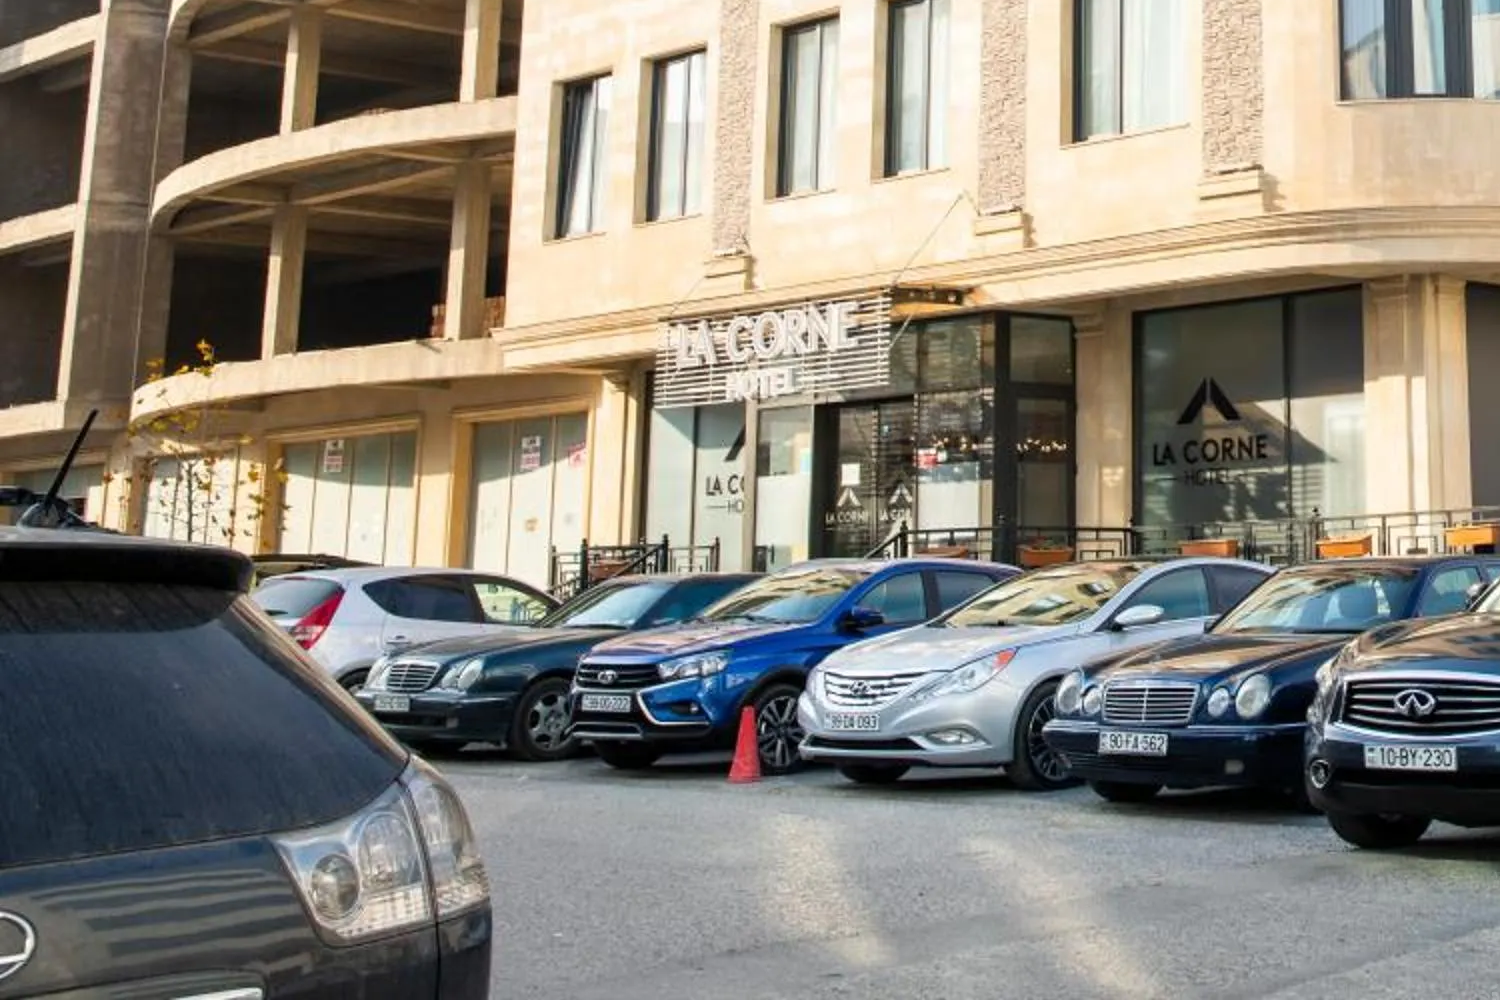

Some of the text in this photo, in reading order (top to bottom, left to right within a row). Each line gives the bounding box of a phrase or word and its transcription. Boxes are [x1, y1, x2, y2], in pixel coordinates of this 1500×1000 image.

[676, 301, 859, 367] LA CORNE
[726, 367, 796, 401] HOTEL
[1153, 434, 1268, 467] LA CORNE
[705, 476, 723, 496] LA
[1380, 747, 1453, 767] 10-BY-230
